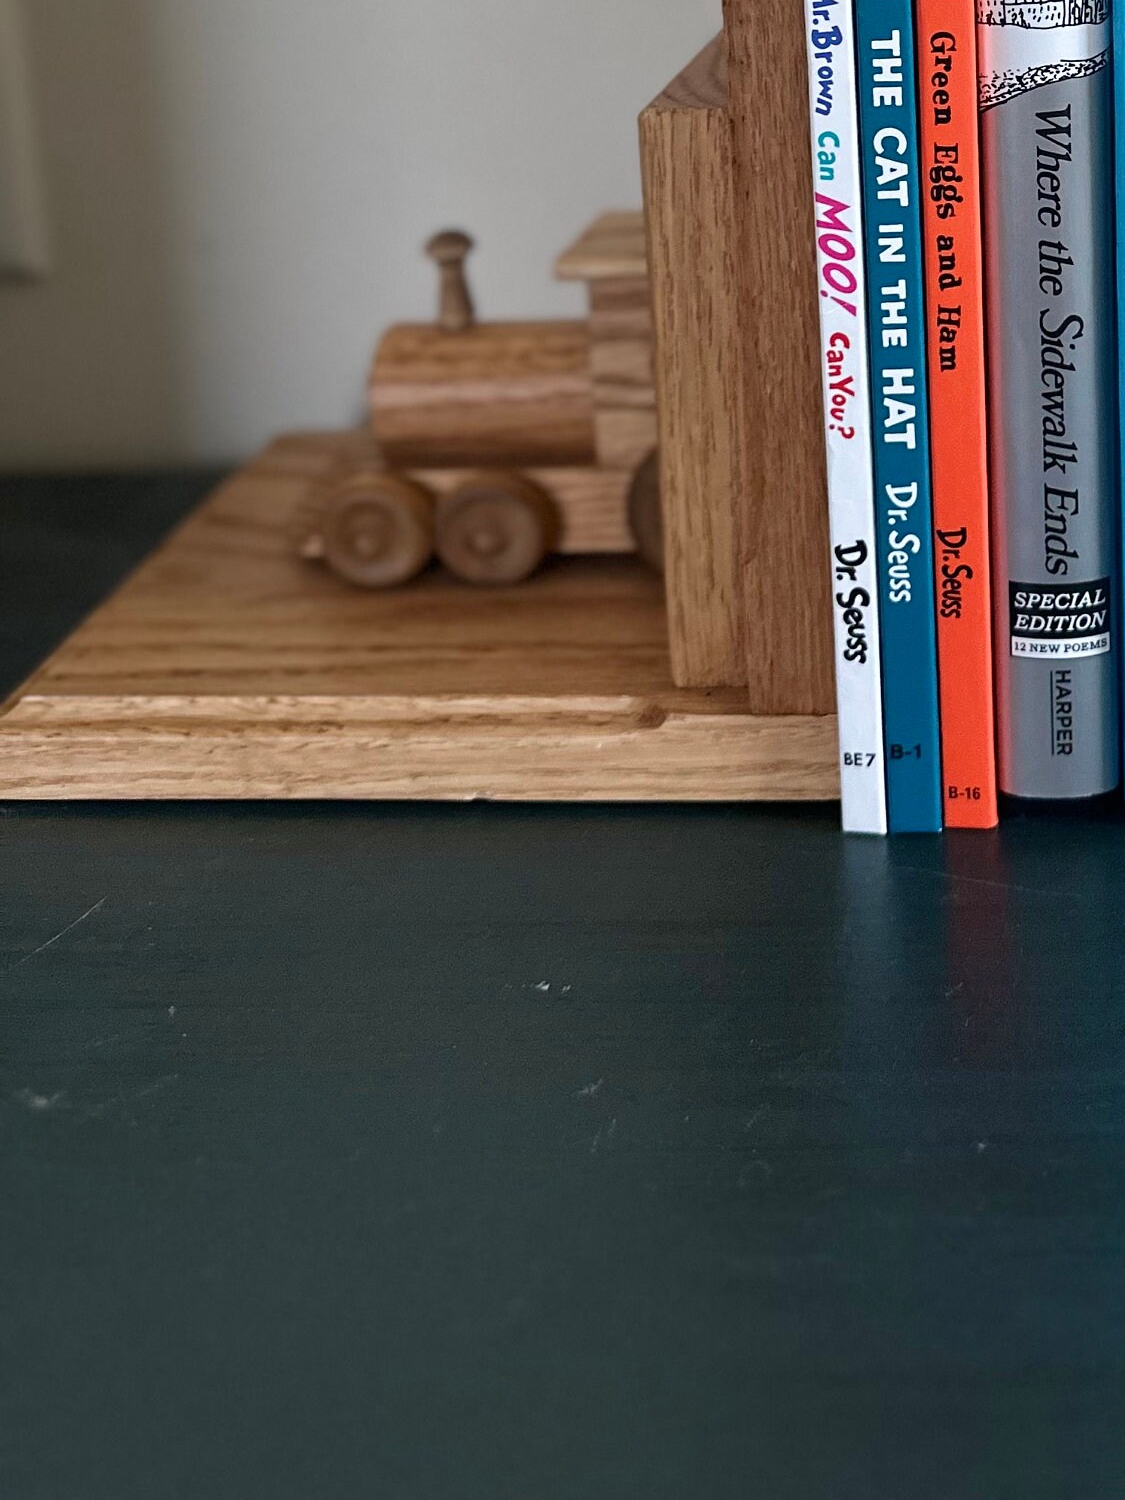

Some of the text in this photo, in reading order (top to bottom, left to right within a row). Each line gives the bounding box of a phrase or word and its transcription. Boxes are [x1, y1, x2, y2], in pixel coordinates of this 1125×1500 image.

[817, 130, 840, 181] Can
[871, 29, 917, 449] THE CAT IN THE HAT
[929, 31, 964, 372] Green Eggs and Ham
[814, 191, 857, 317] MOO!
[1035, 103, 1084, 576] Where the Sidewalk Ends
[885, 481, 920, 603] Dr. Seuss
[937, 527, 973, 619] Dr. Seuss
[835, 539, 870, 664] Dr. Seuss
[1014, 589, 1105, 610] SPECIAL
[1014, 609, 1107, 632] EDITION
[1014, 637, 1108, 653] 12 NEW POEMS
[890, 743, 921, 759] B-1
[1055, 669, 1073, 756] HARPER
[948, 786, 980, 800] B-16
